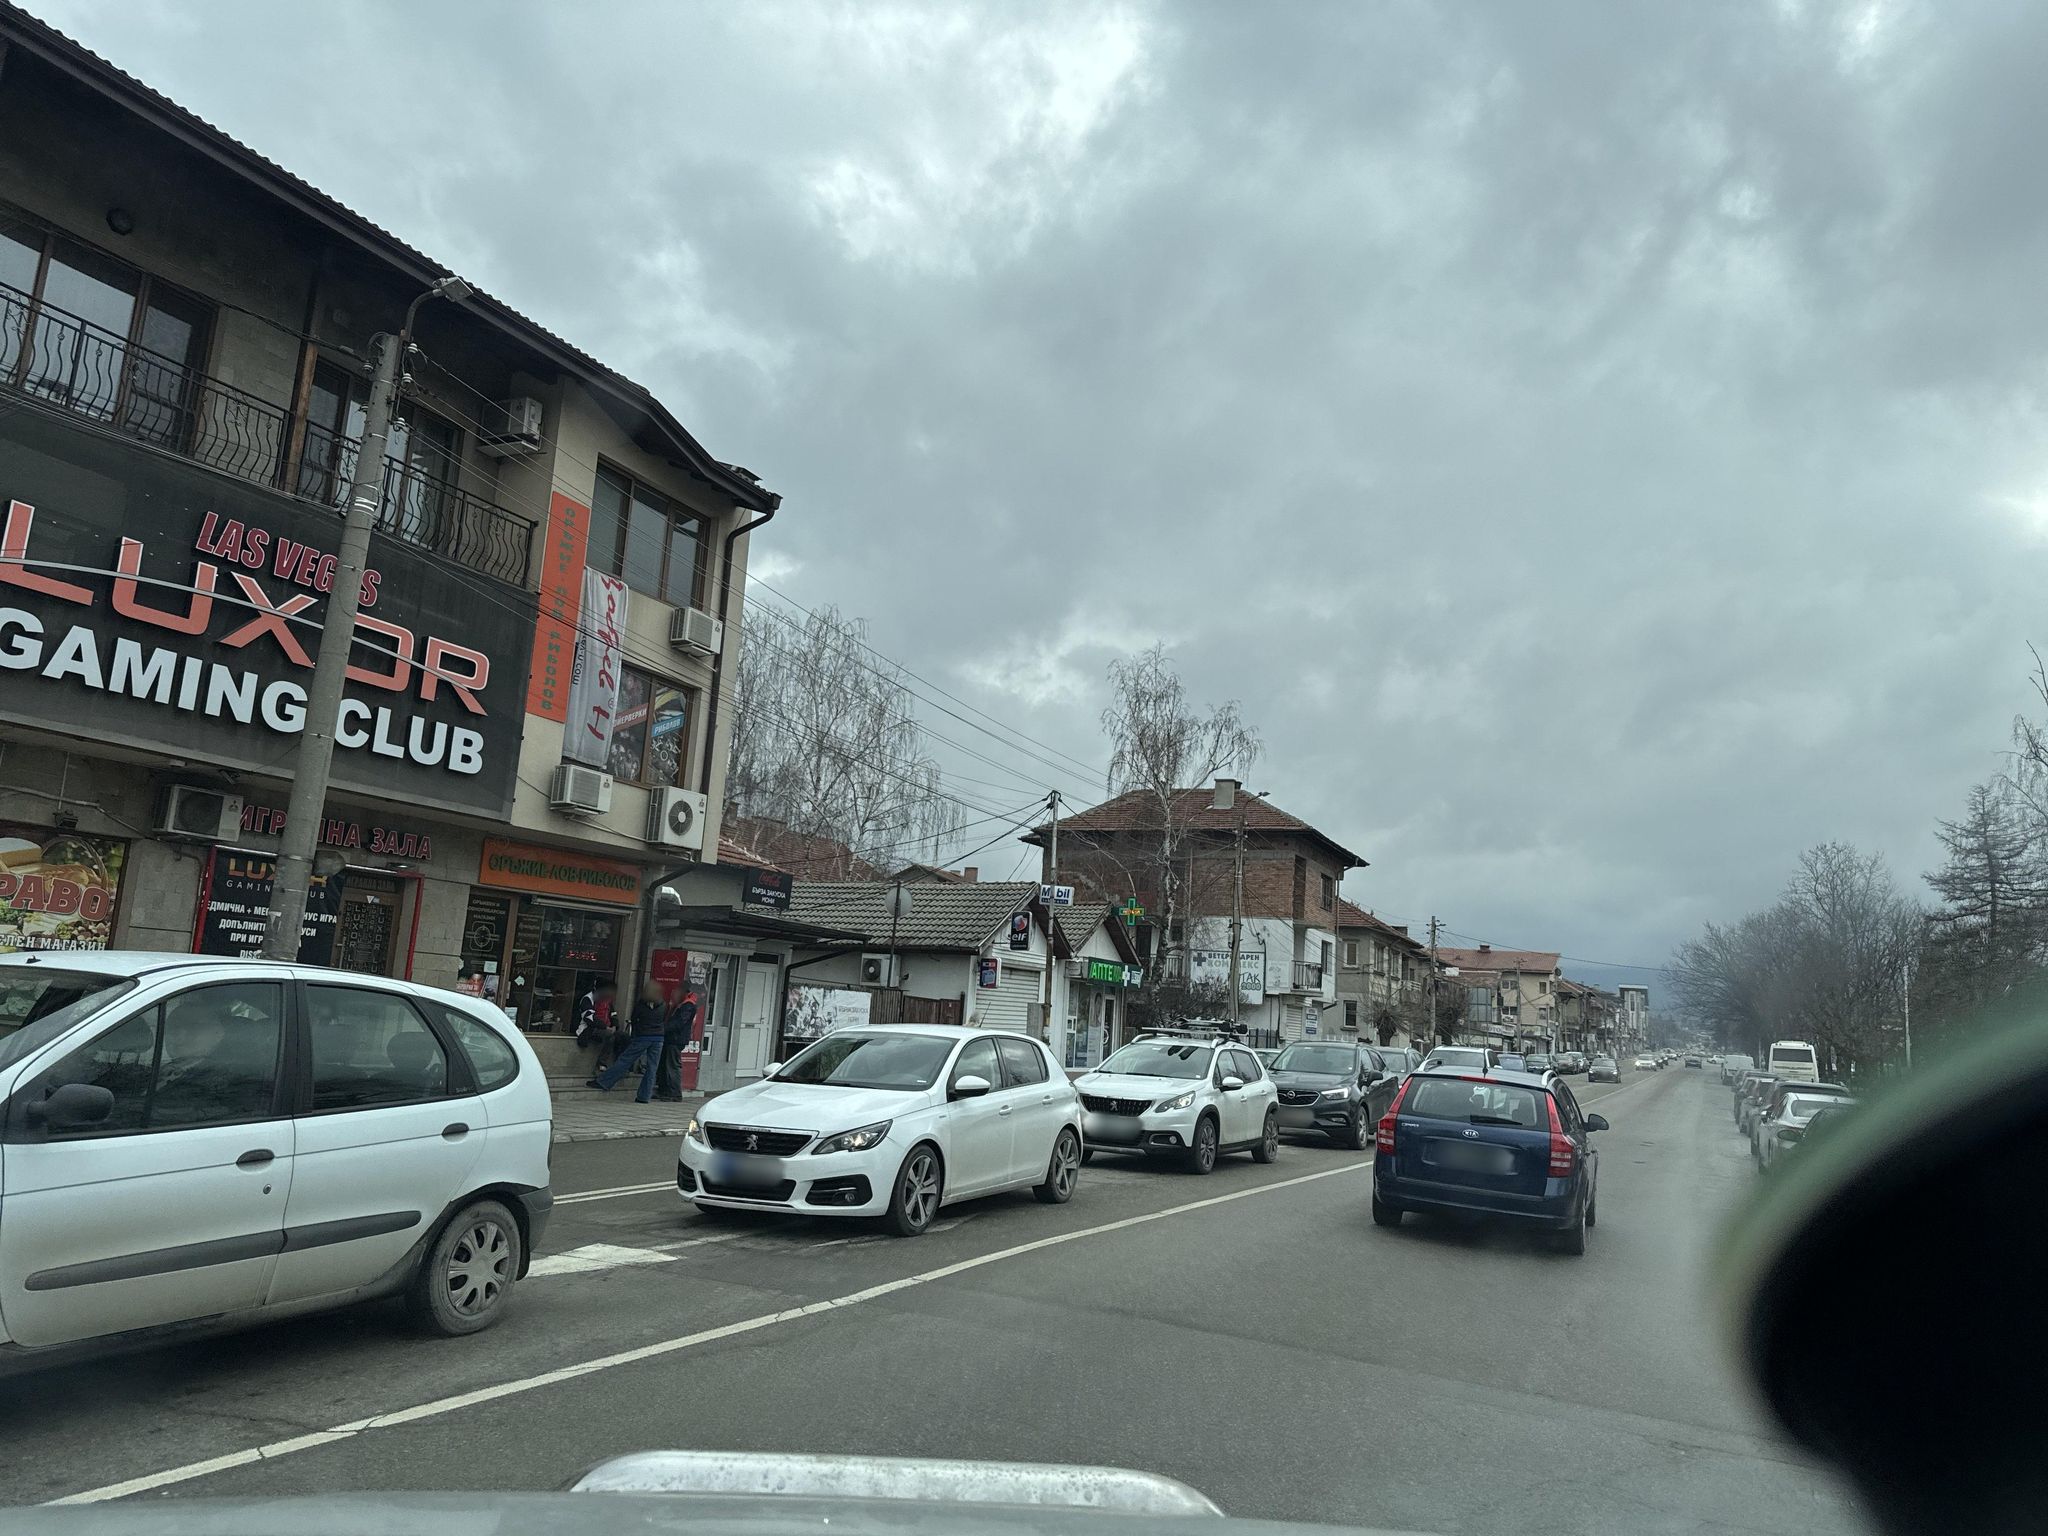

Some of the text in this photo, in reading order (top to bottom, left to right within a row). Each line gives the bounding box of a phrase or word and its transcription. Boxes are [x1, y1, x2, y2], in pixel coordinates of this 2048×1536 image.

[195, 511, 381, 607] LAS VEGS
[0, 607, 484, 774] GAMING CLUB
[239, 805, 432, 860] ИГРНА ЗАЛА
[226, 880, 272, 892] GAMIN
[1042, 887, 1070, 899] Mbil
[207, 900, 245, 914] ЕДМИЧНА
[320, 913, 337, 924] ИГРА
[219, 918, 266, 932] ДОПЪЛНИТ
[230, 932, 264, 944] ПРИ ИГР
[1012, 932, 1028, 942] elf
[40, 937, 107, 951] МАГАЗИН
[1208, 953, 1260, 961] ВЕТЕРАРЕН
[1207, 960, 1259, 969] КОМЕКС
[1241, 982, 1262, 991] 2000
